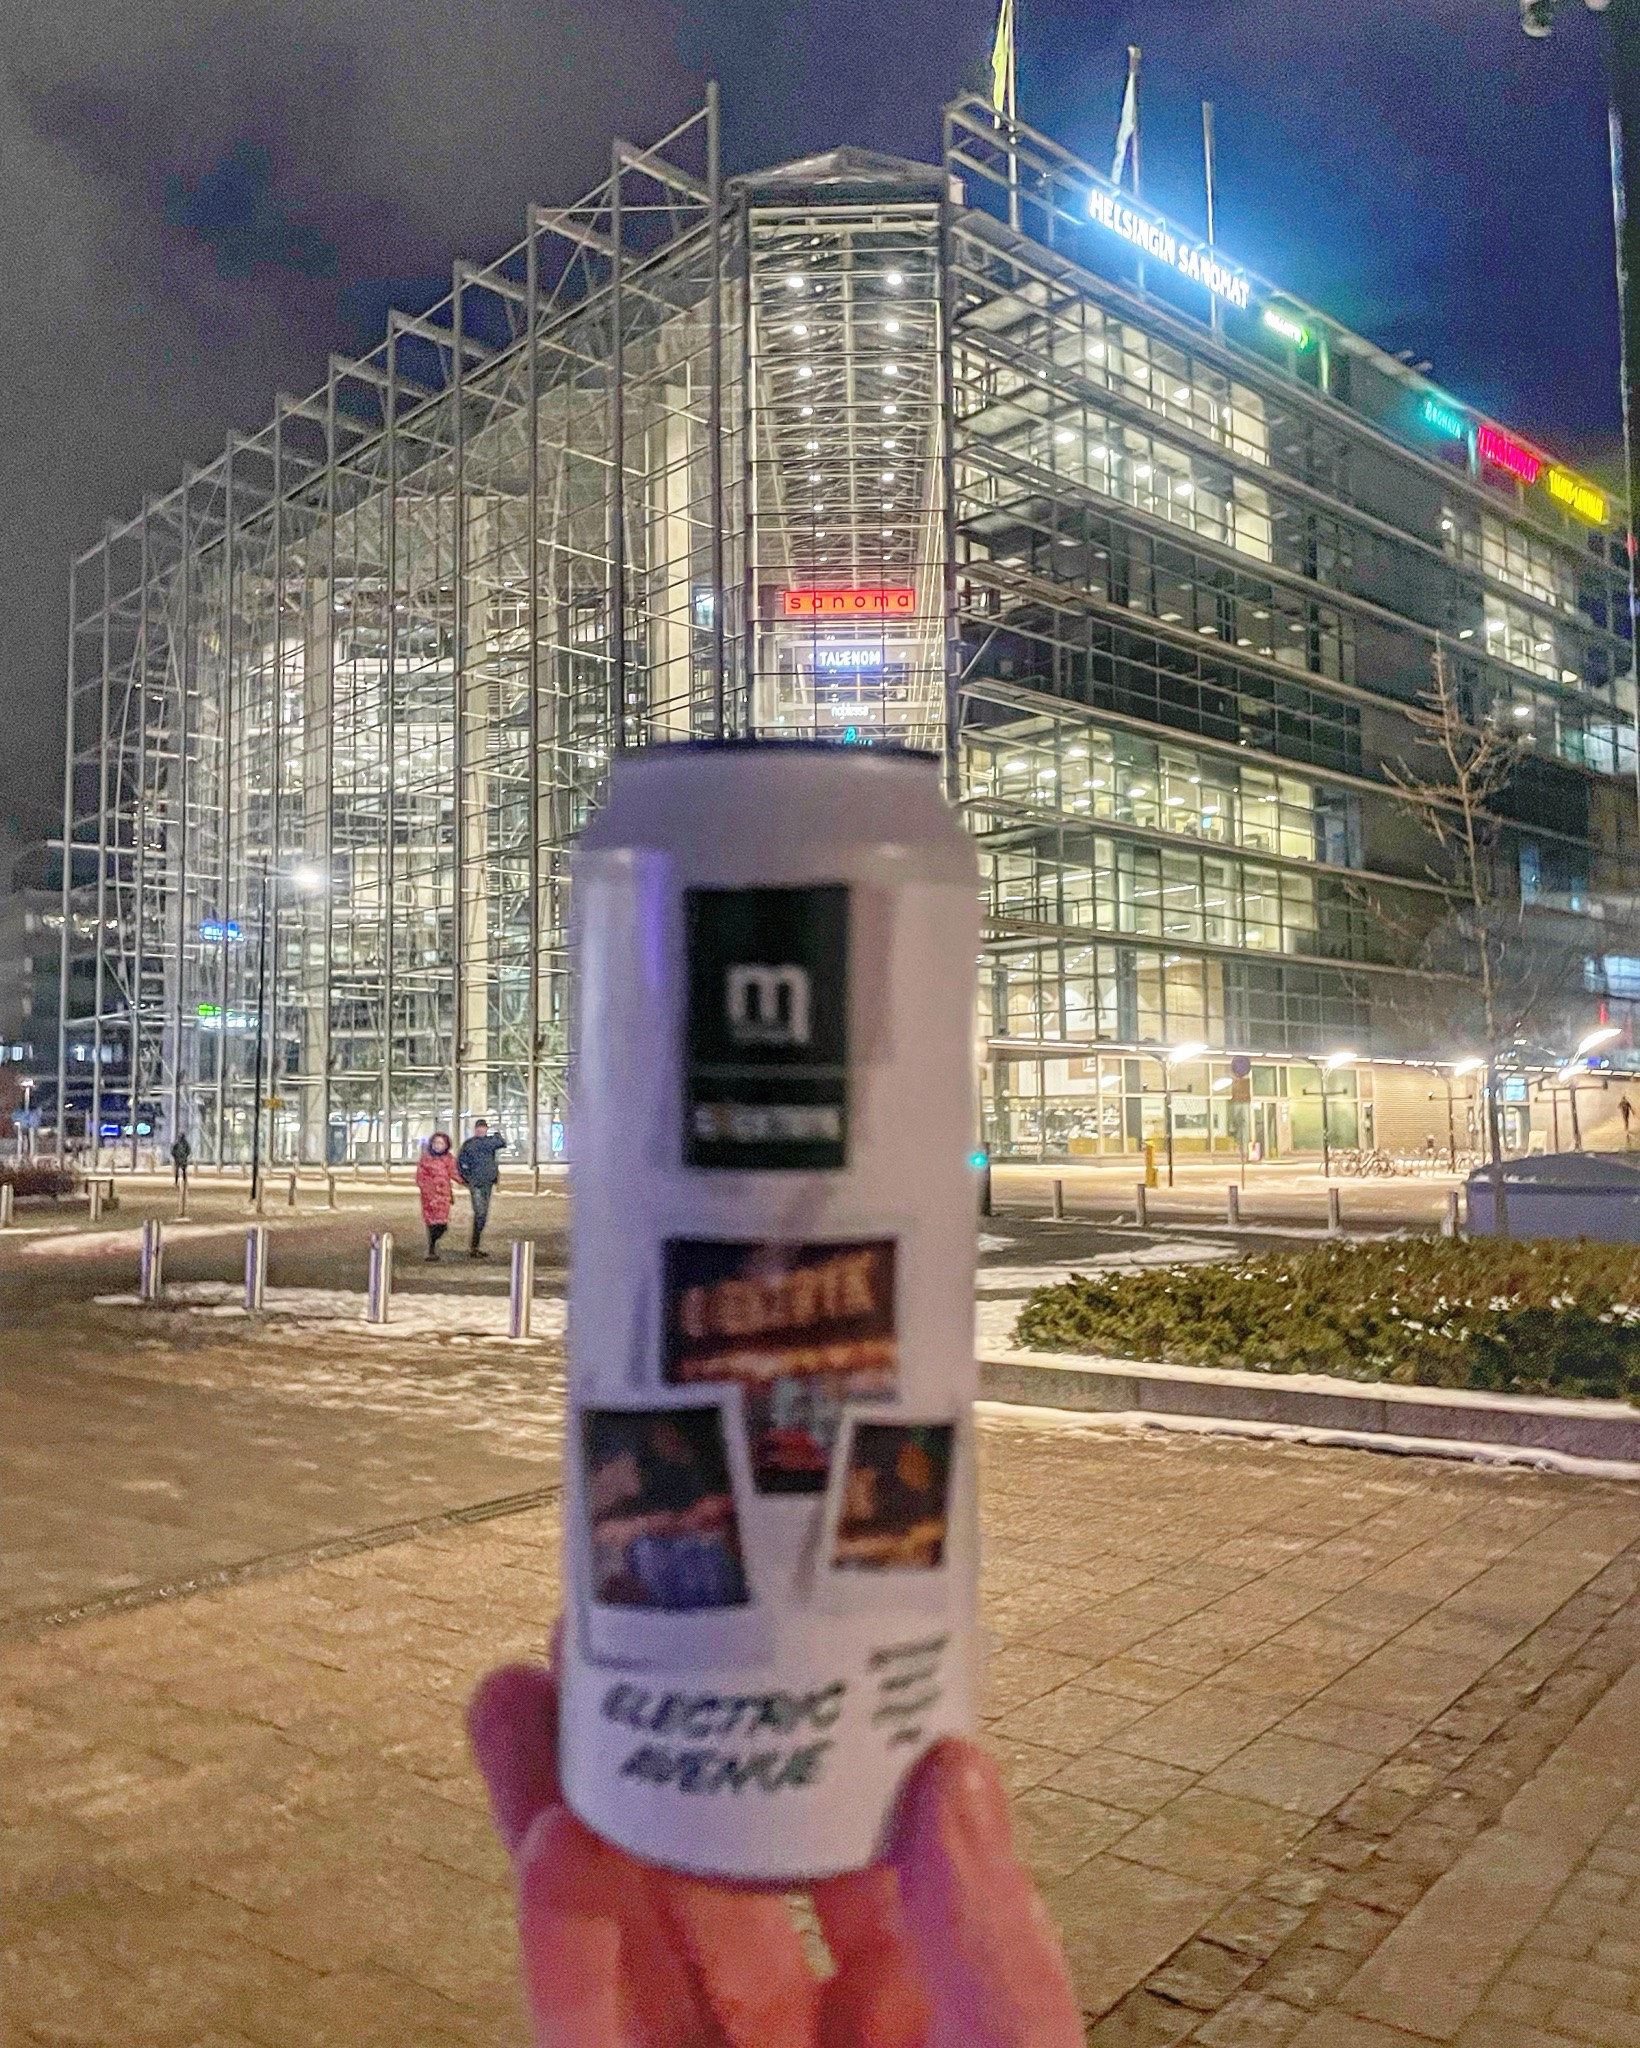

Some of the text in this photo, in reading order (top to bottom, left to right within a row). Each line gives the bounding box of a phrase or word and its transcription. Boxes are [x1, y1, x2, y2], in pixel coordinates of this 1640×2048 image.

[1089, 188, 1250, 310] HELSINGIN SANOMAT
[790, 594, 909, 610] sanoma
[819, 650, 881, 666] TALENOM
